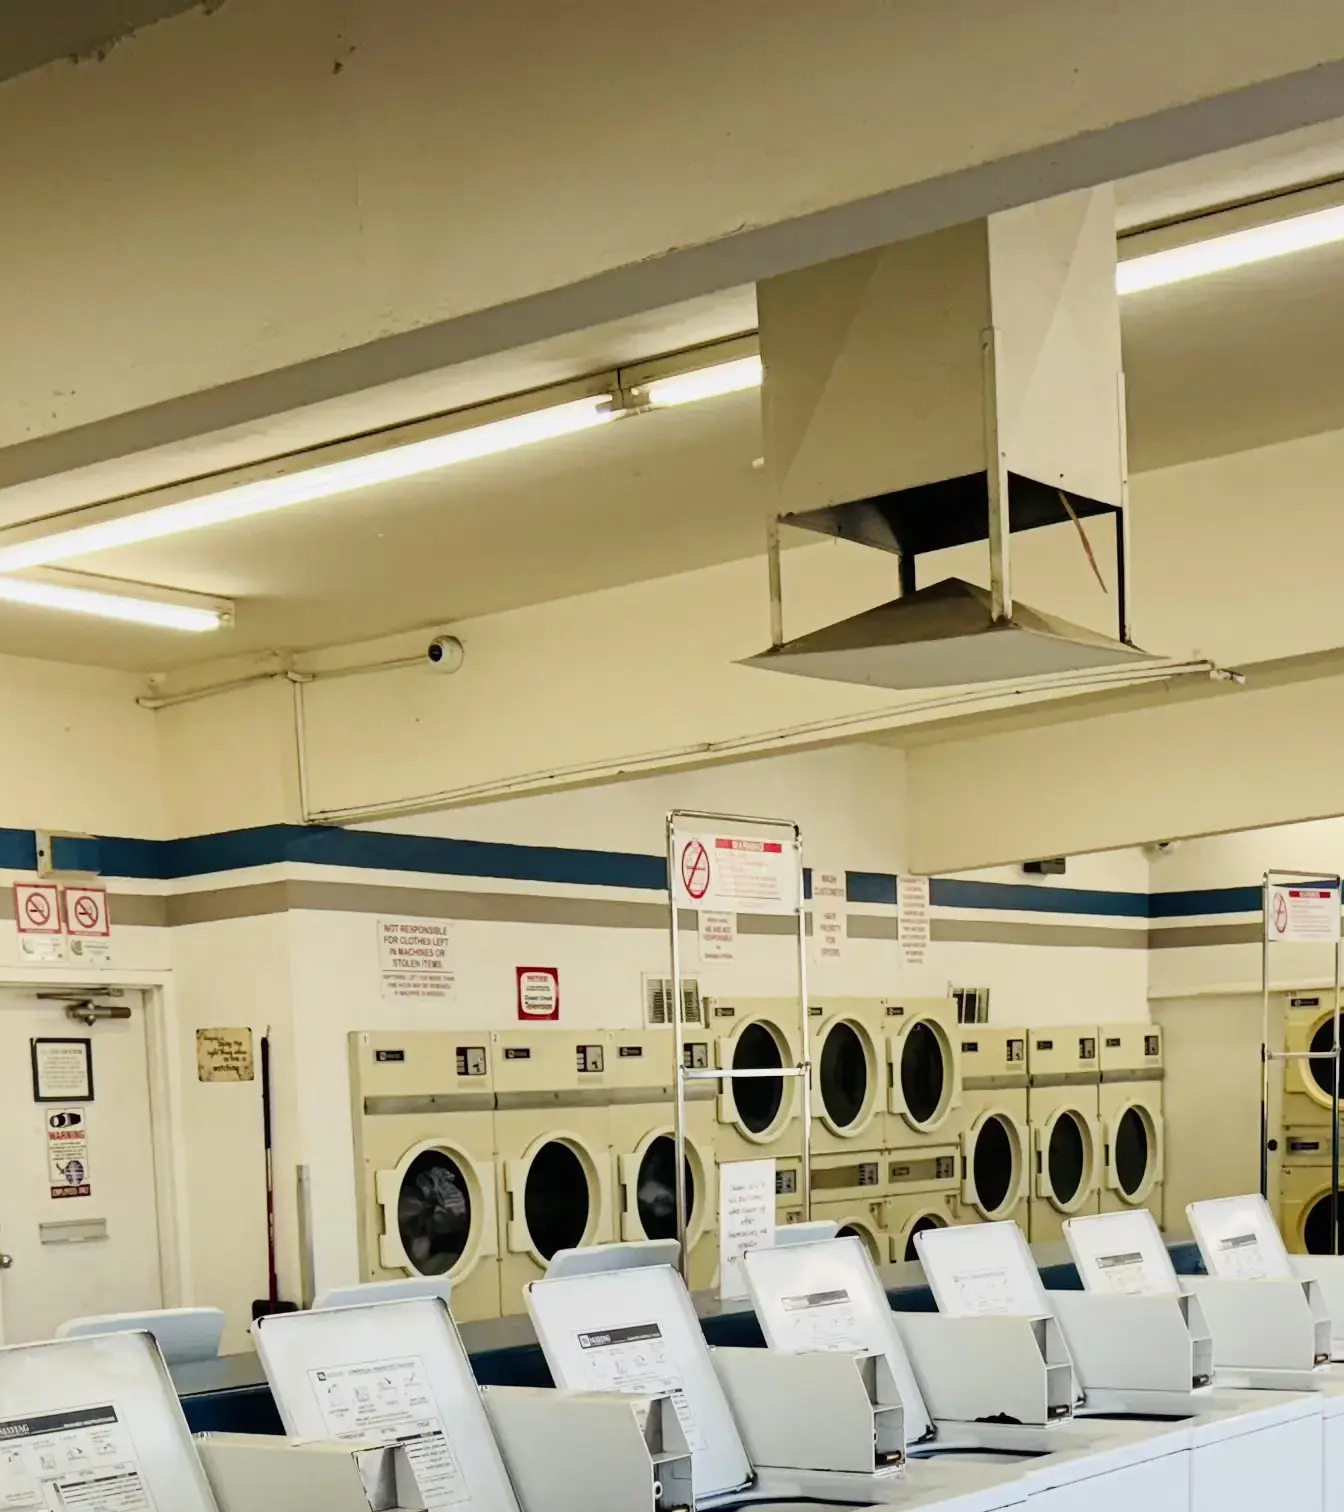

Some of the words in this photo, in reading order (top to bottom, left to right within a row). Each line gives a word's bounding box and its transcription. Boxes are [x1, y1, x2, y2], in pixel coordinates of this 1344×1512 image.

[383, 924, 399, 933] NOT
[400, 925, 447, 936] RESPONSIBLE
[383, 935, 398, 945] FOR
[399, 936, 432, 946] CLOTHES
[432, 937, 449, 947] LEFT
[392, 958, 421, 968] STOLEN
[47, 1130, 86, 1141] WARNING
